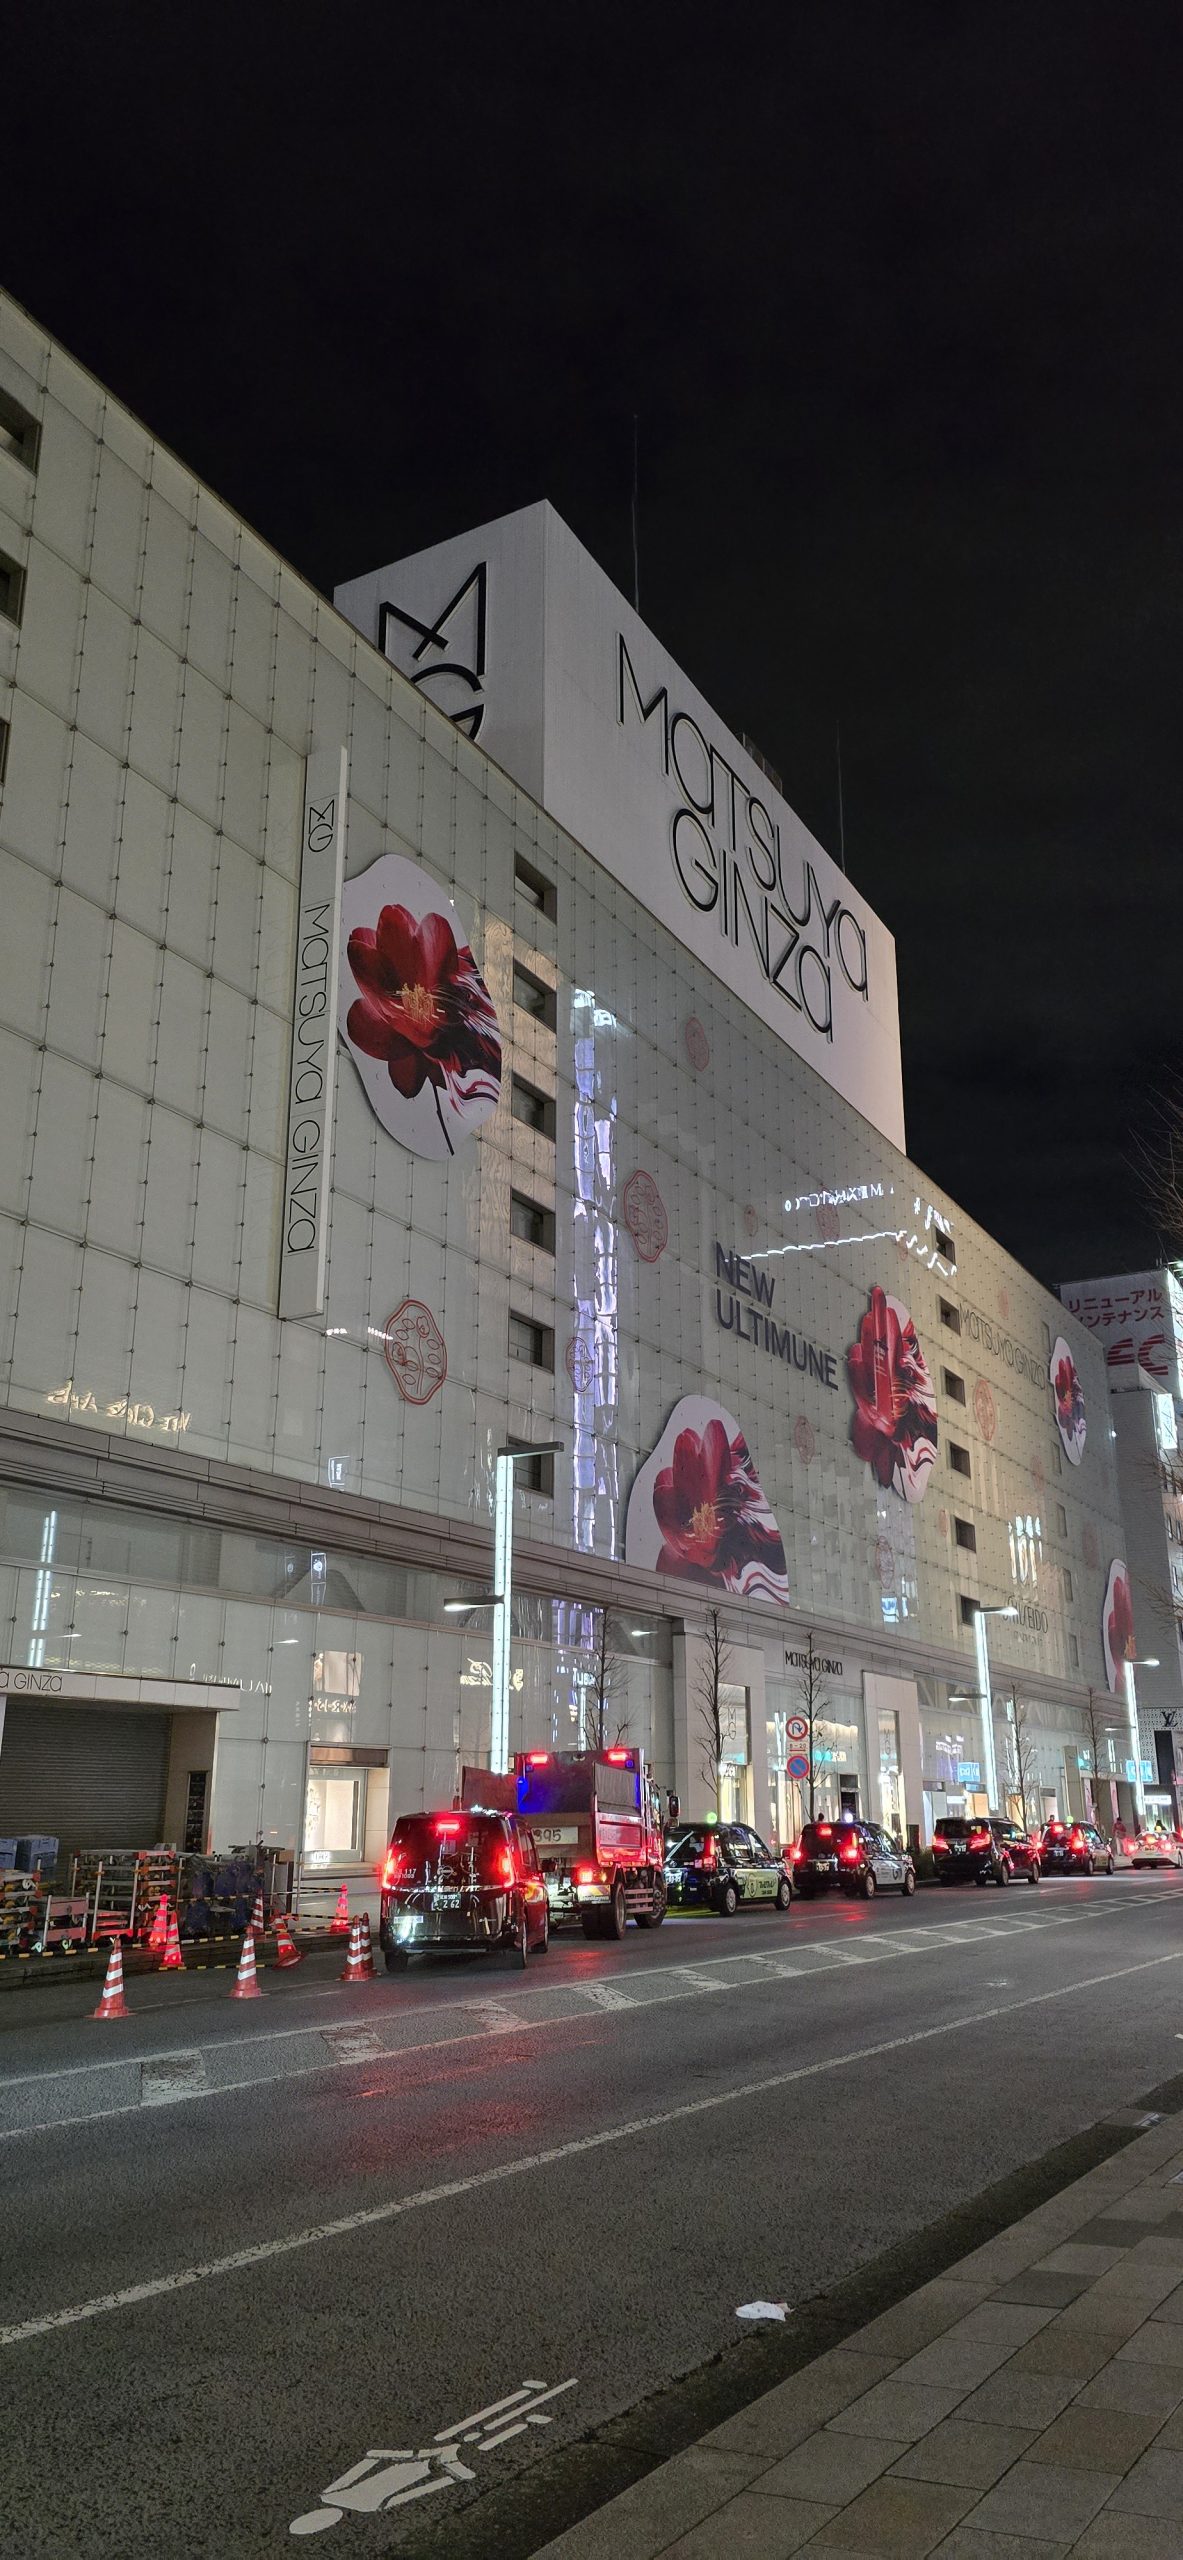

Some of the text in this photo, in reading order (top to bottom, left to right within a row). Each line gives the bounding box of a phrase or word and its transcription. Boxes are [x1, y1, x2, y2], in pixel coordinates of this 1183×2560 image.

[716, 1241, 776, 1309] NEW
[1067, 1288, 1163, 1314] リニューアル
[1080, 1306, 1165, 1329] ンテナンス
[716, 1288, 839, 1392] ULTIMUNE
